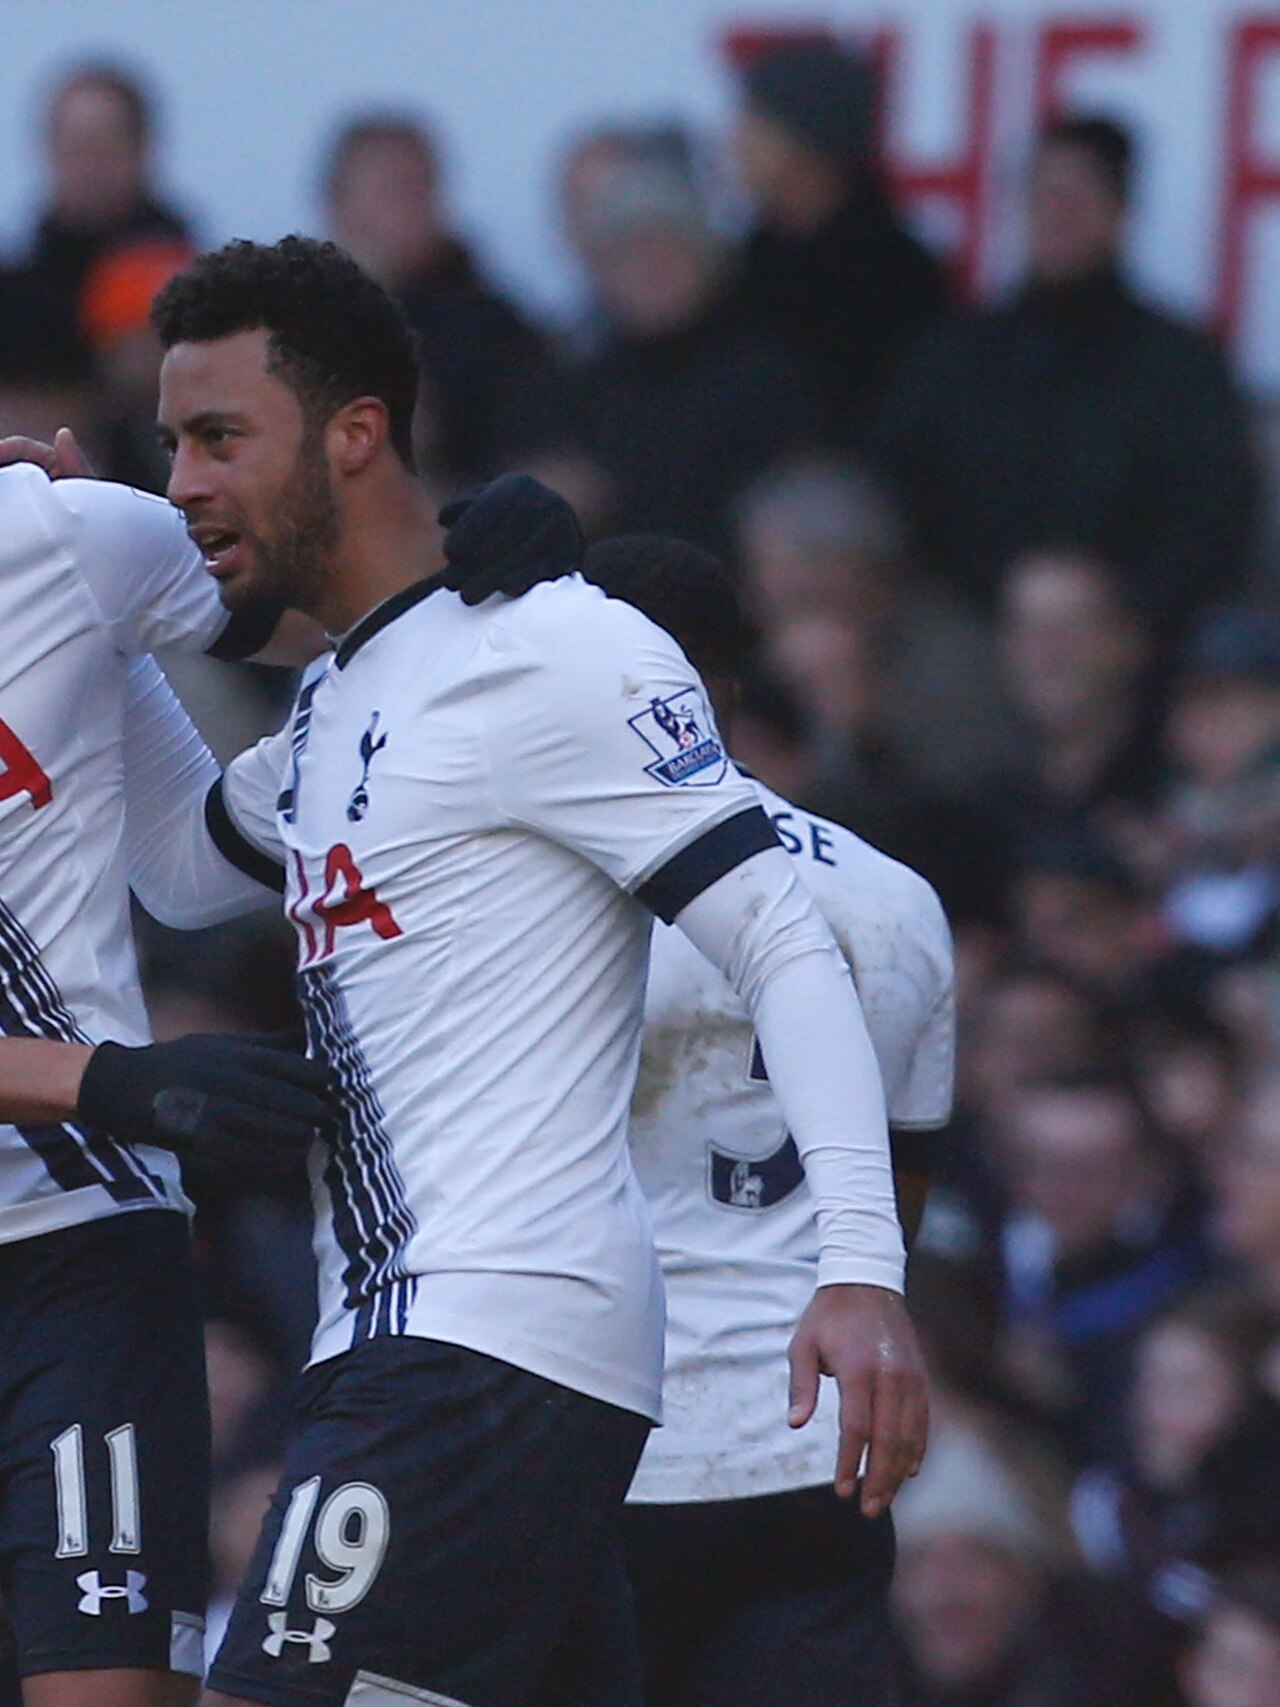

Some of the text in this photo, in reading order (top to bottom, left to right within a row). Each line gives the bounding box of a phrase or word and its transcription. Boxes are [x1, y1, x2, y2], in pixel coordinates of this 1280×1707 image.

[771, 812, 838, 868] SE
[50, 1423, 141, 1559] 11
[259, 1474, 391, 1614] 19
